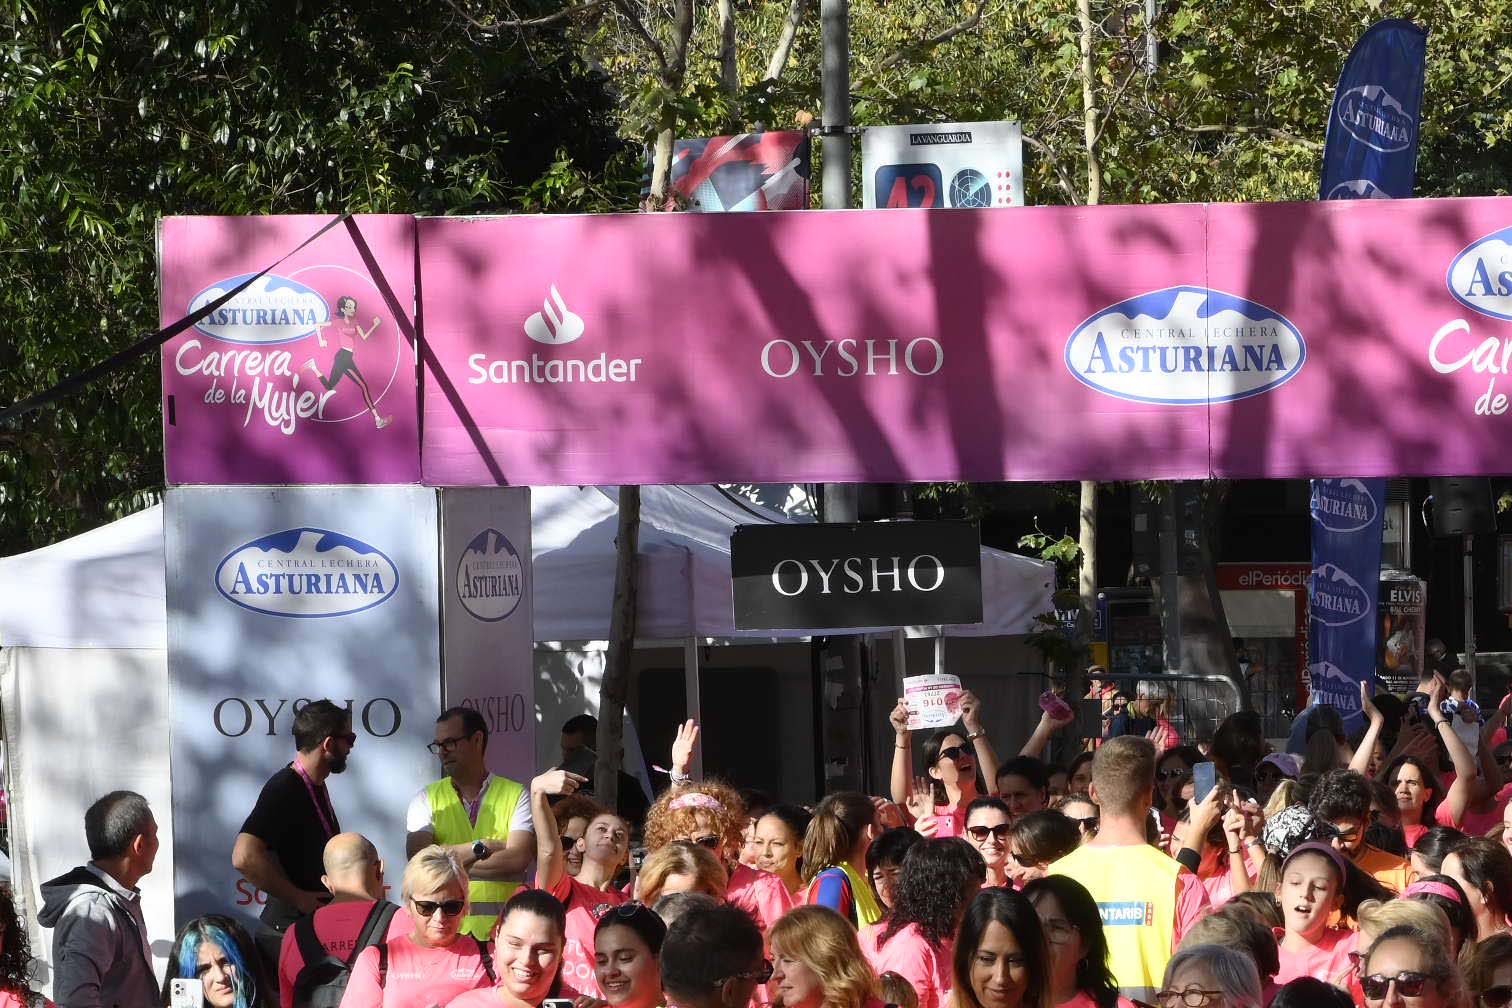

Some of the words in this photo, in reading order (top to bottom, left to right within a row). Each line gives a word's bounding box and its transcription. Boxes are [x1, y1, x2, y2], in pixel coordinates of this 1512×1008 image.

[1084, 331, 1287, 374] ASTURIANA
[1121, 327, 1195, 339] CENTRAL
[175, 339, 293, 377] Carrera
[468, 352, 643, 385] Santander
[761, 337, 945, 379] OYSHO
[204, 378, 226, 404] de
[231, 377, 246, 404] la
[243, 372, 337, 435] Mujer
[1474, 378, 1509, 417] de
[230, 561, 386, 596] ASTURIANA
[258, 559, 316, 569] CENTRAL
[322, 559, 379, 569] LECHERA
[462, 559, 520, 599] ASTURIANA
[772, 554, 945, 596] OYSHO
[1390, 590, 1421, 602] ELVIS
[463, 693, 526, 732] YSHO
